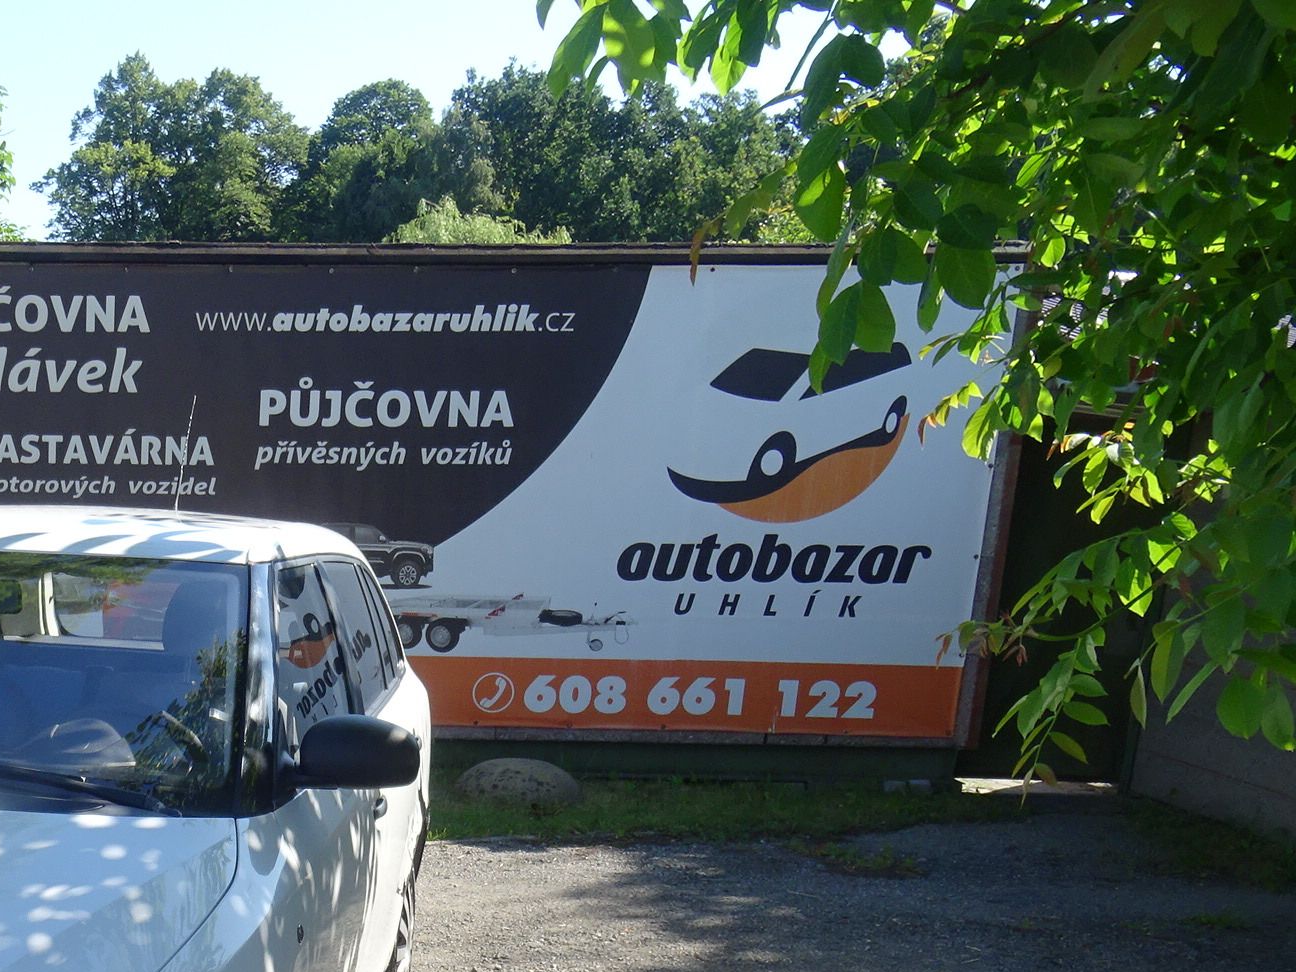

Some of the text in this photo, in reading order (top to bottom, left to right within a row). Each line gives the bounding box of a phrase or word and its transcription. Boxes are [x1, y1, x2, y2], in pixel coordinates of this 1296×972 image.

[195, 304, 576, 333] www.autobazaruhlik.cz
[258, 376, 514, 428] PŮJČOVNA
[254, 439, 513, 471] přívěsných vozíků
[128, 476, 217, 496] vozidel
[616, 532, 933, 585] autobazar
[523, 674, 878, 720] 608 661 122
